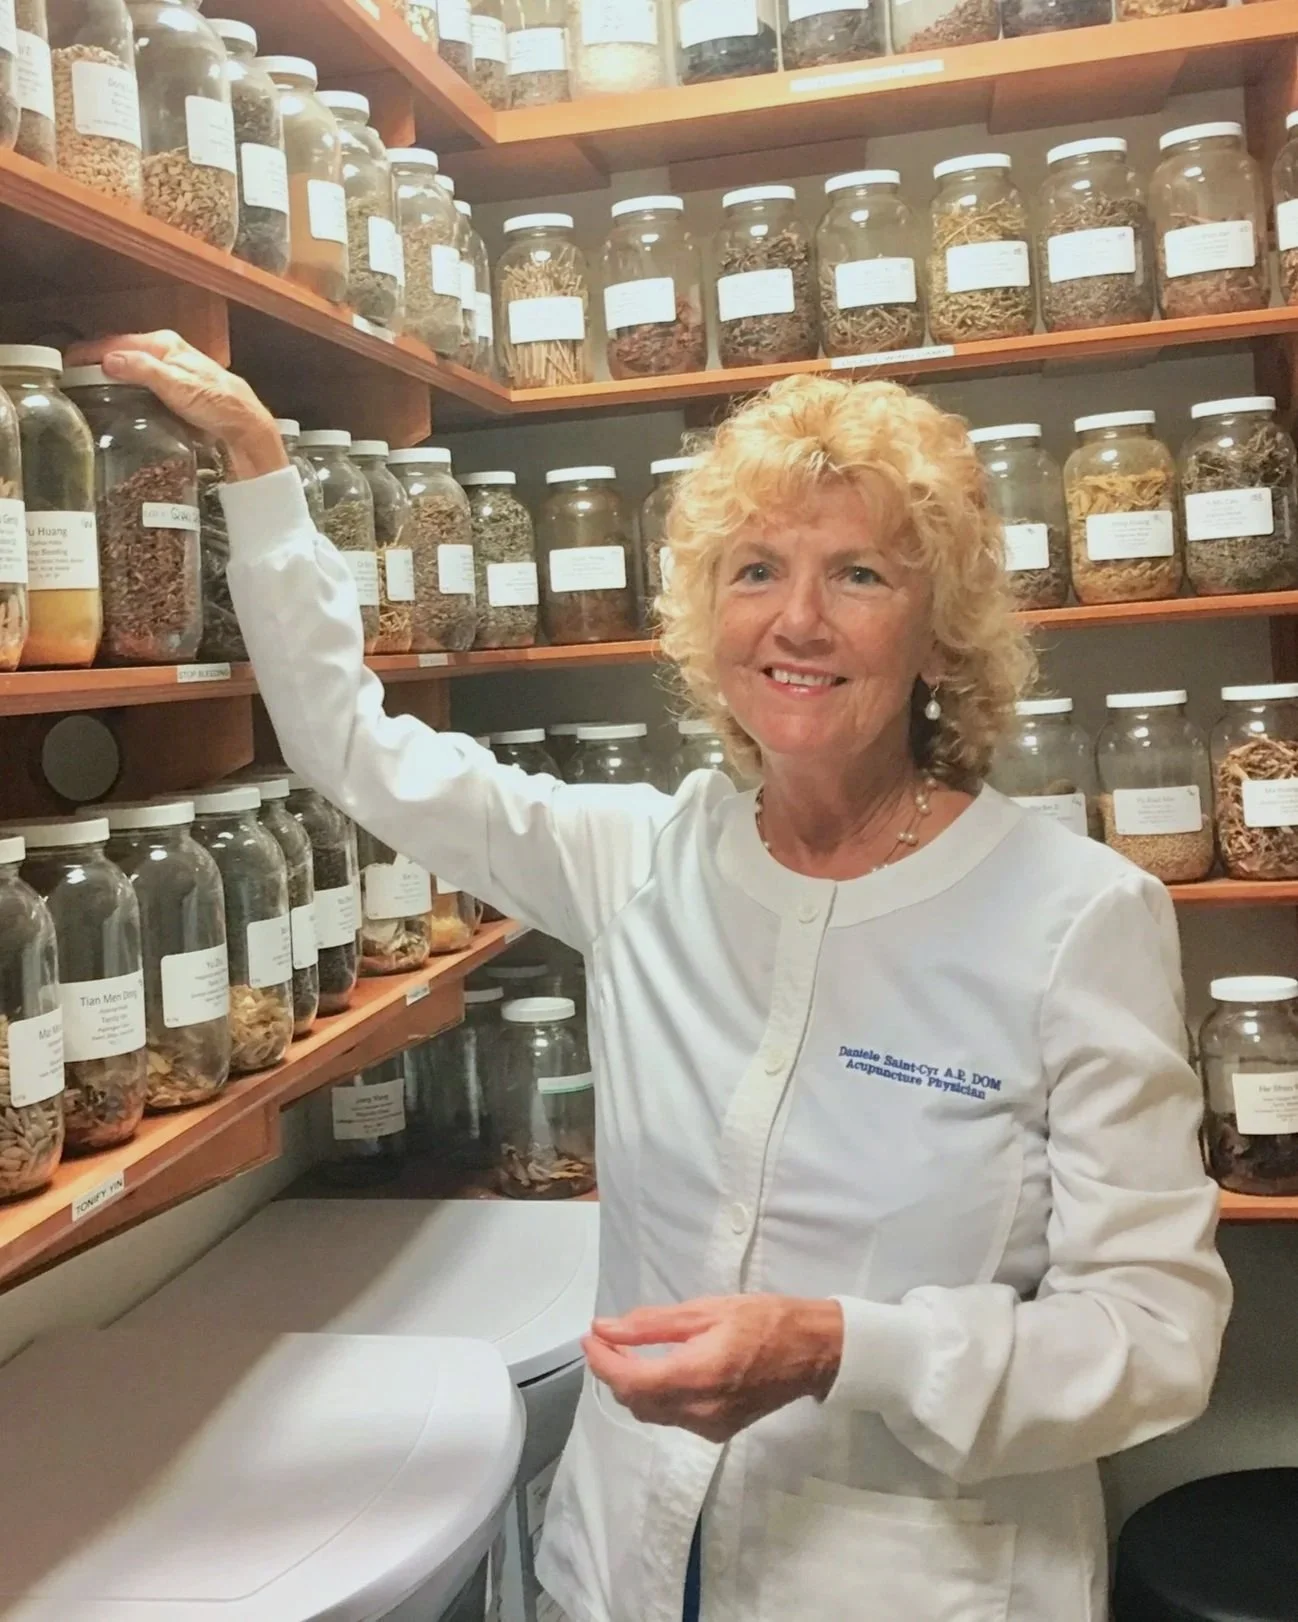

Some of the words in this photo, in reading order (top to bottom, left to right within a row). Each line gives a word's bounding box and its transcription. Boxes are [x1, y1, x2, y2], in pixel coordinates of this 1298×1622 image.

[38, 527, 67, 538] Huang
[80, 997, 101, 1008] Tian
[103, 993, 121, 1005] Men
[838, 1045, 881, 1062] Daniele
[883, 1054, 939, 1076] Saint-Cyr
[971, 1072, 1002, 1091] DOM
[846, 1059, 922, 1086] Acupuncture
[927, 1076, 987, 1100] Physician
[76, 1188, 107, 1216] TONIFY
